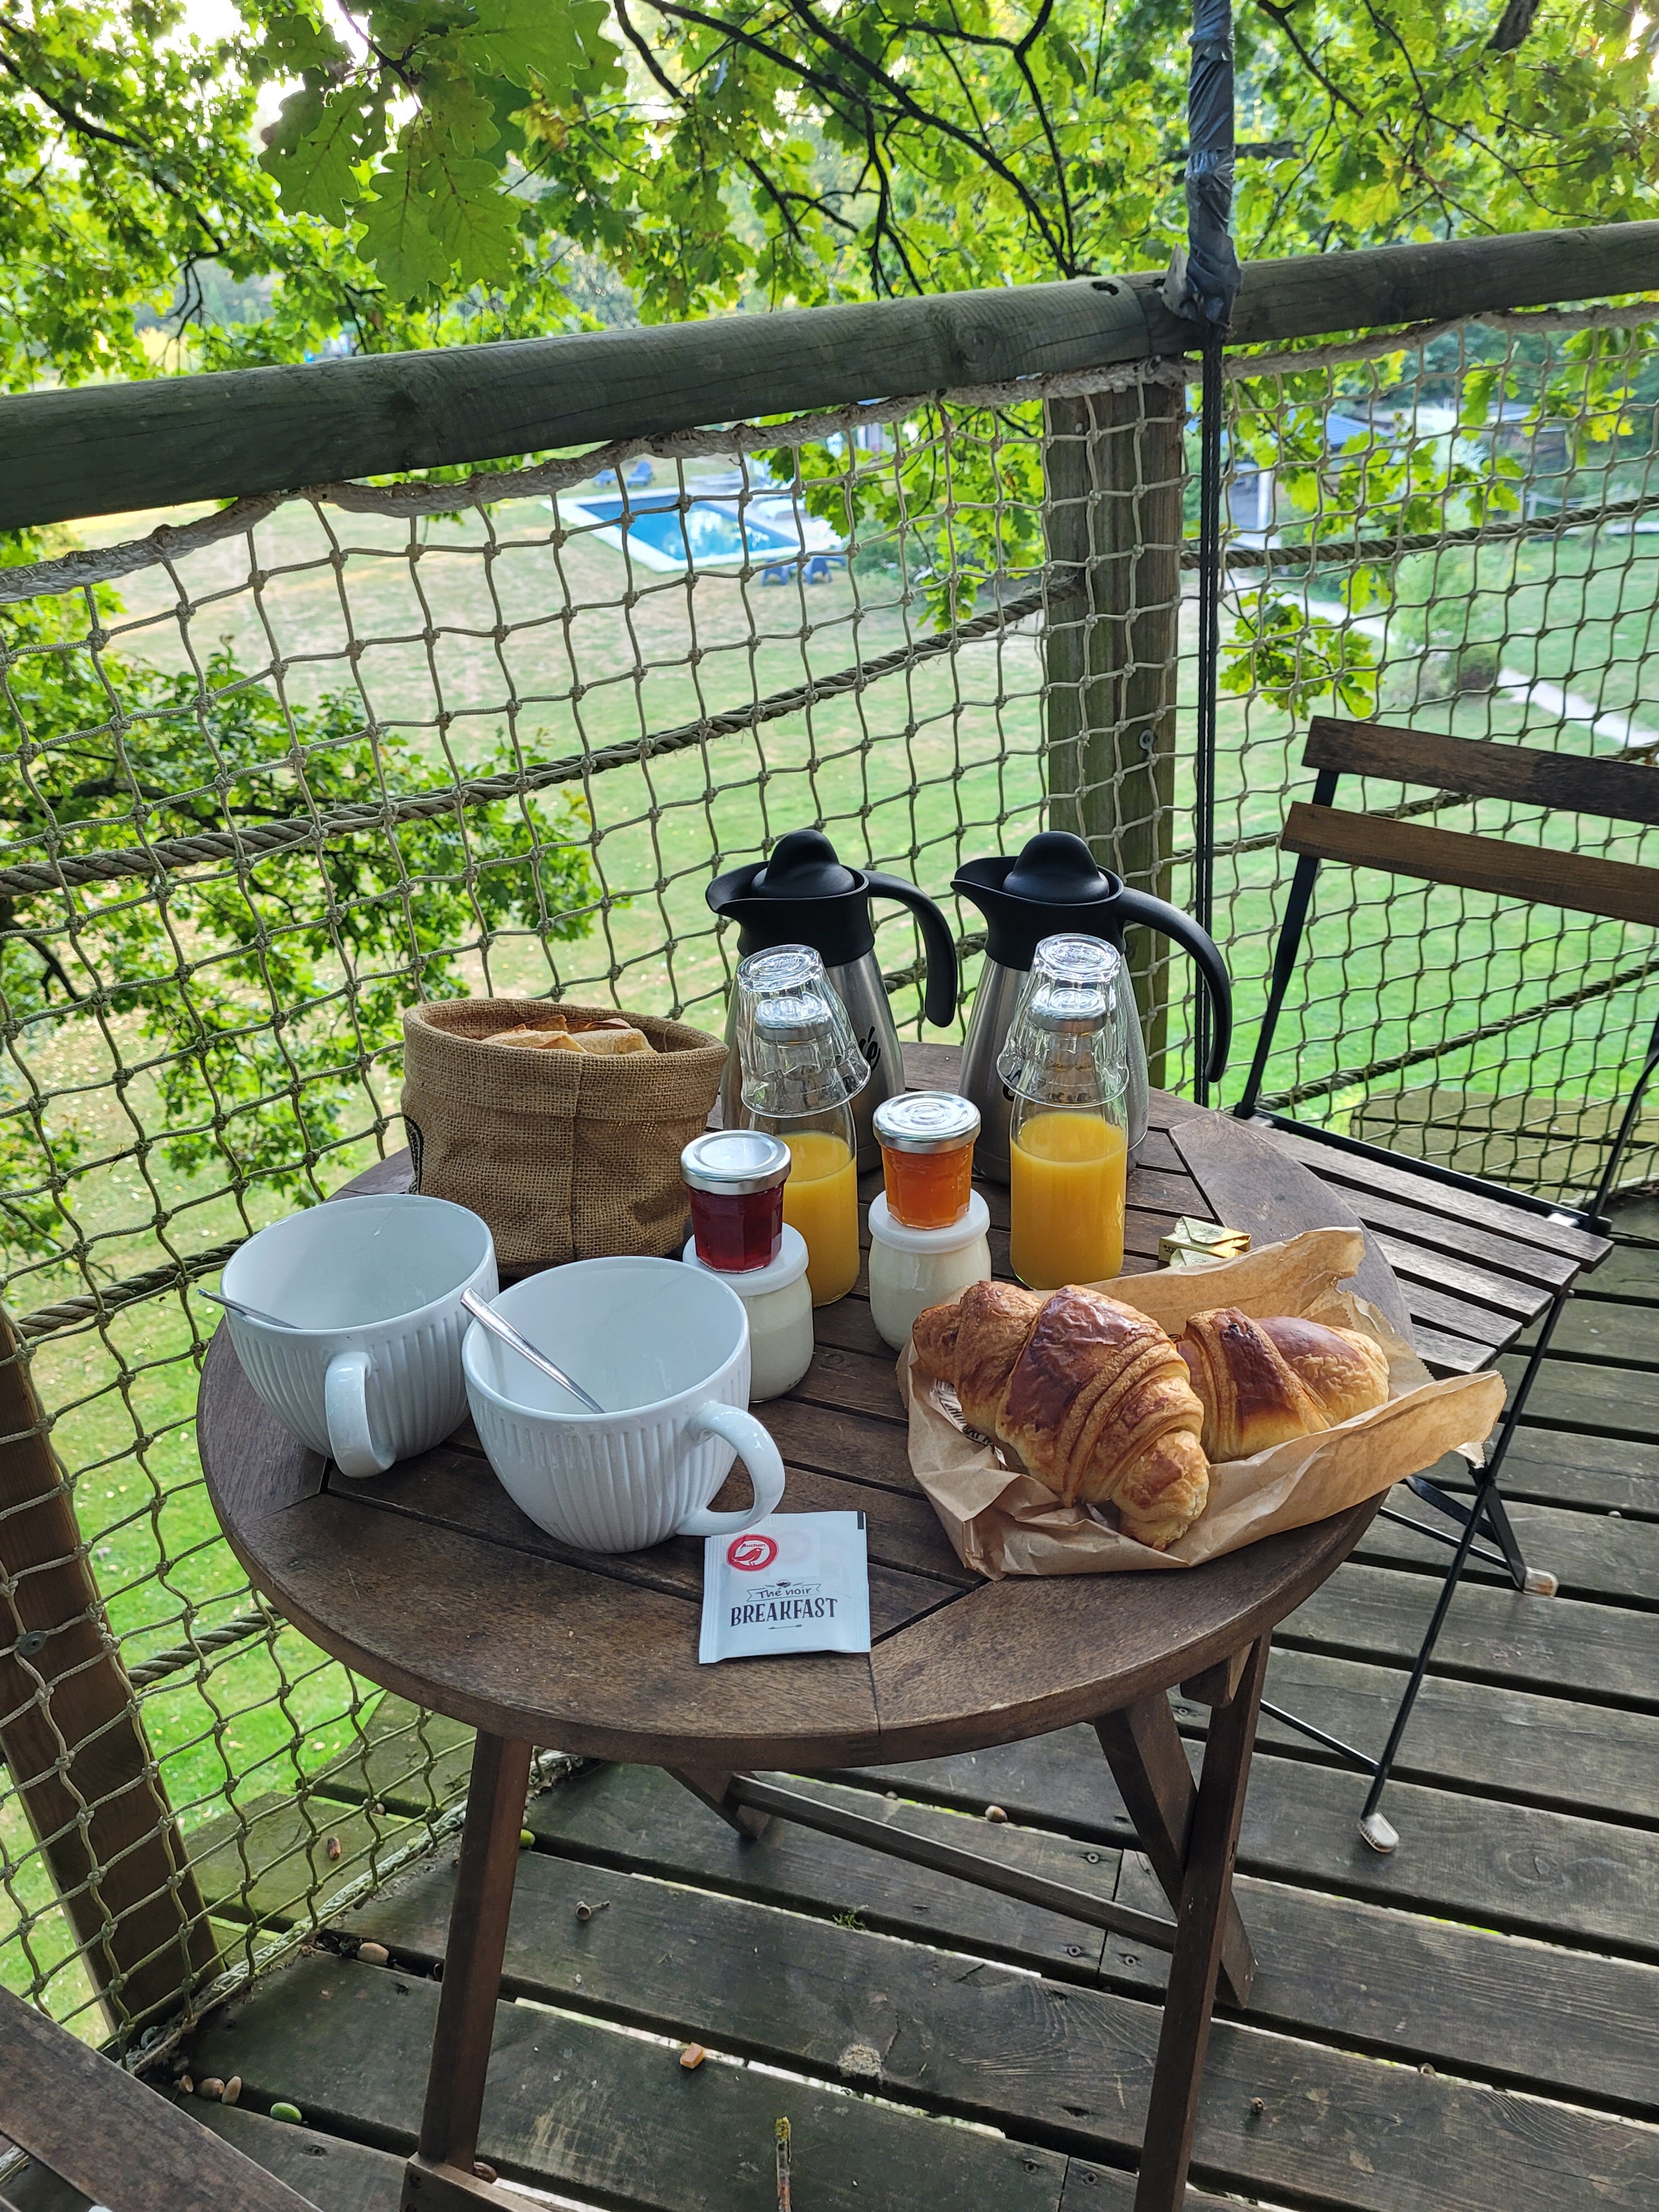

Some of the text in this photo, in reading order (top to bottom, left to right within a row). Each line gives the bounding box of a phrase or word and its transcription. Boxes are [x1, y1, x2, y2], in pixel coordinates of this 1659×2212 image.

[755, 1586, 811, 1599] Thé noir
[730, 1597, 838, 1627] BREAKFAST
